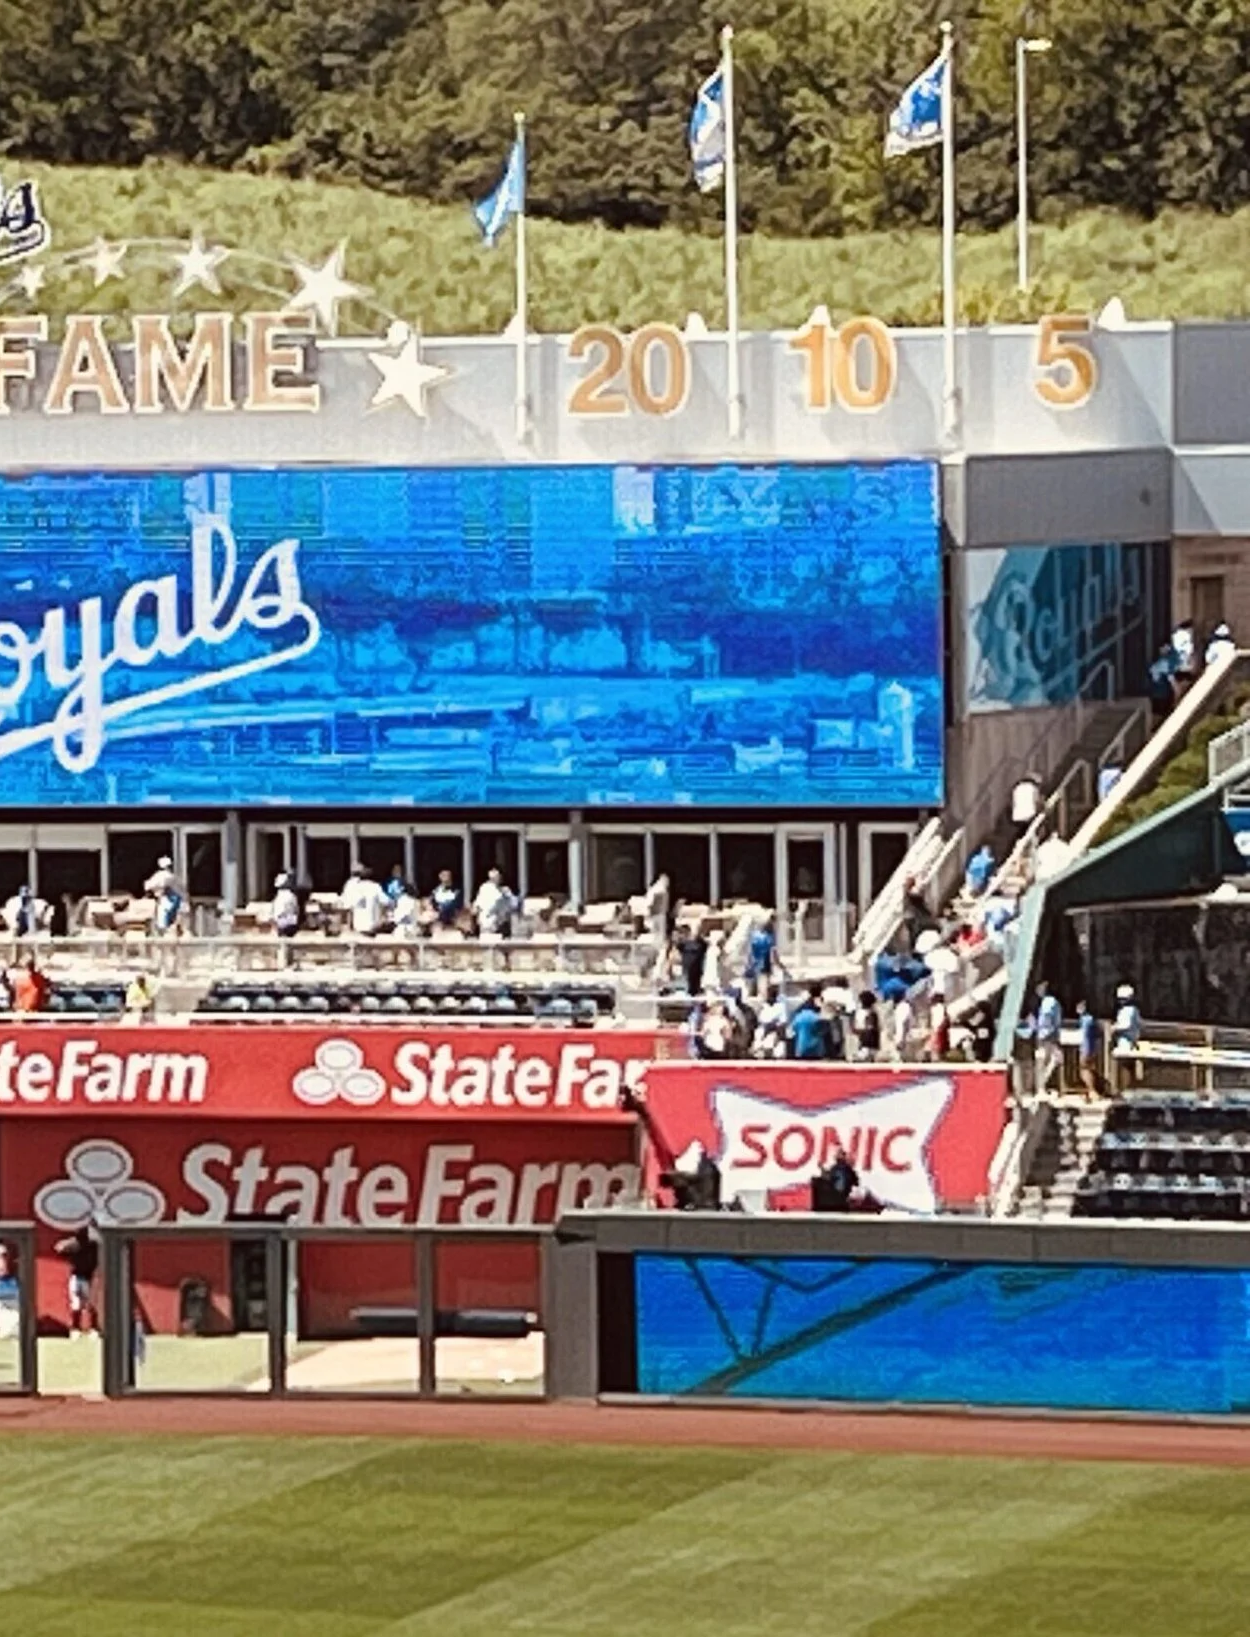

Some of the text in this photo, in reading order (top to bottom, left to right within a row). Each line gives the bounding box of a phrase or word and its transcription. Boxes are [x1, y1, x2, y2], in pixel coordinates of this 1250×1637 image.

[567, 322, 691, 418] 20
[787, 315, 897, 414] 10
[1033, 313, 1097, 410] 5
[731, 1123, 917, 1173] SONIC
